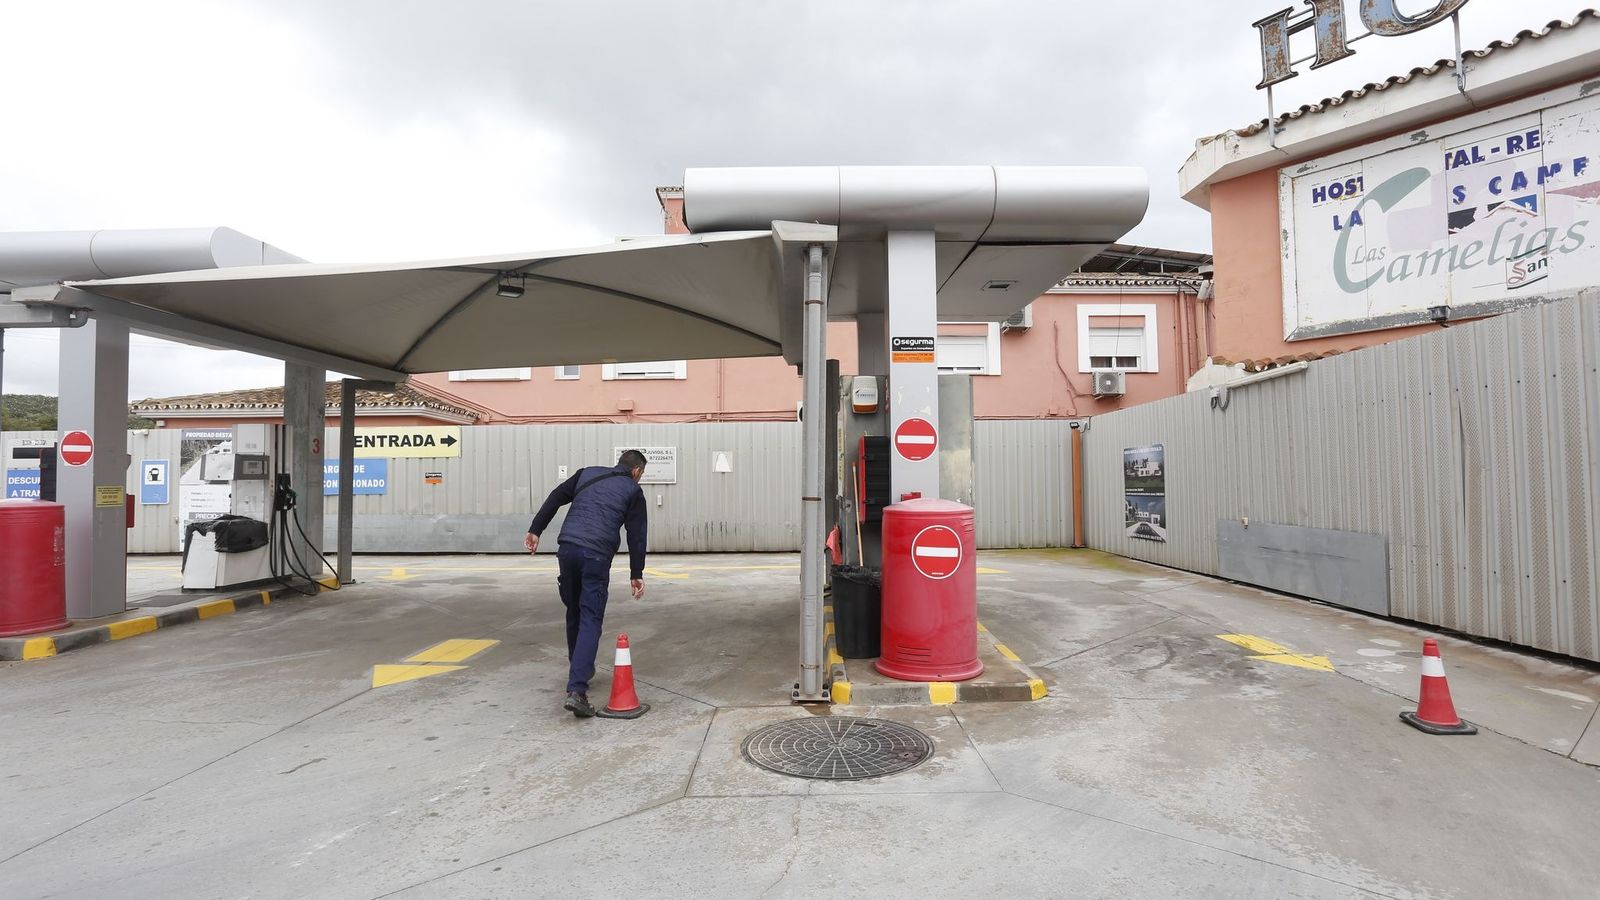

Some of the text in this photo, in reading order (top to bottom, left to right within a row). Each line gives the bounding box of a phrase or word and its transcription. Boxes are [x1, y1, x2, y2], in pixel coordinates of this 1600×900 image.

[1333, 167, 1589, 294] Camelias
[1352, 245, 1386, 265] Las
[312, 438, 321, 454] 3
[353, 434, 436, 448] ENTRADA
